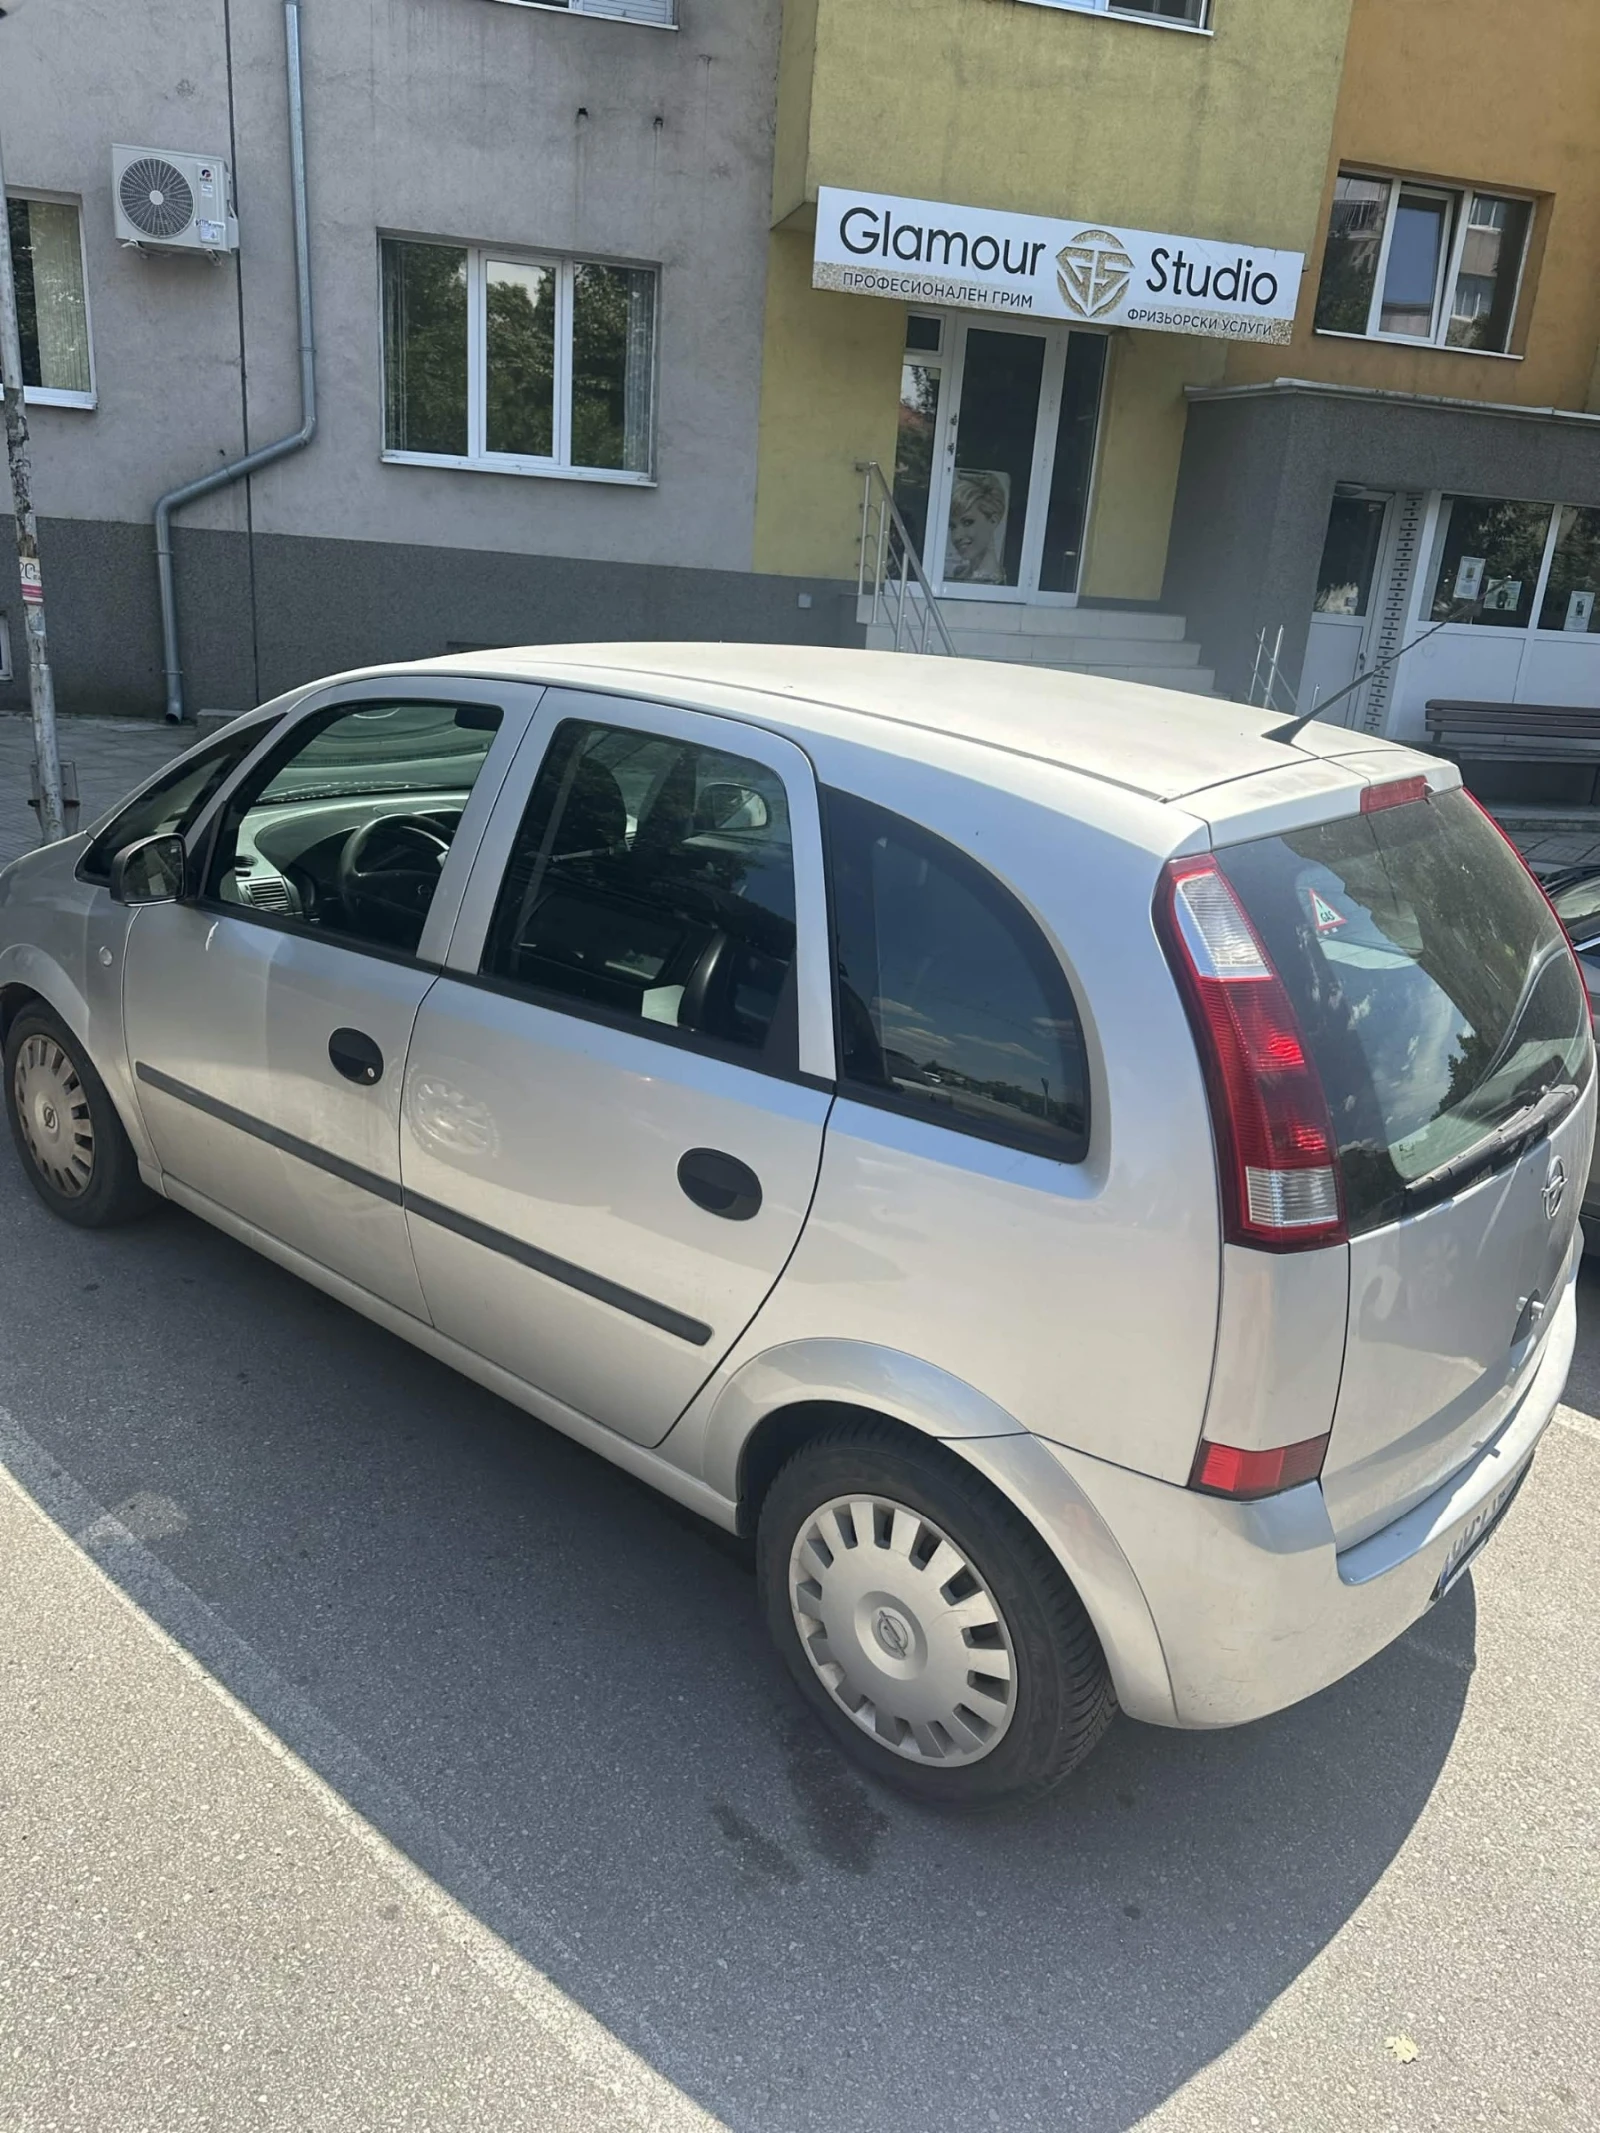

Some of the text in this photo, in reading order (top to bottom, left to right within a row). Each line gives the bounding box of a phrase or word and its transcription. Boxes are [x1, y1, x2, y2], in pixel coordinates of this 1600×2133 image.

[839, 206, 1278, 306] Glamour Studio
[842, 272, 1033, 309] ПРОФЕСИОНАЛЕН ГРИМ
[1127, 308, 1272, 336] ФРИЗЬОРСКИ УСЛУГИ
[1320, 910, 1336, 922] GAS
